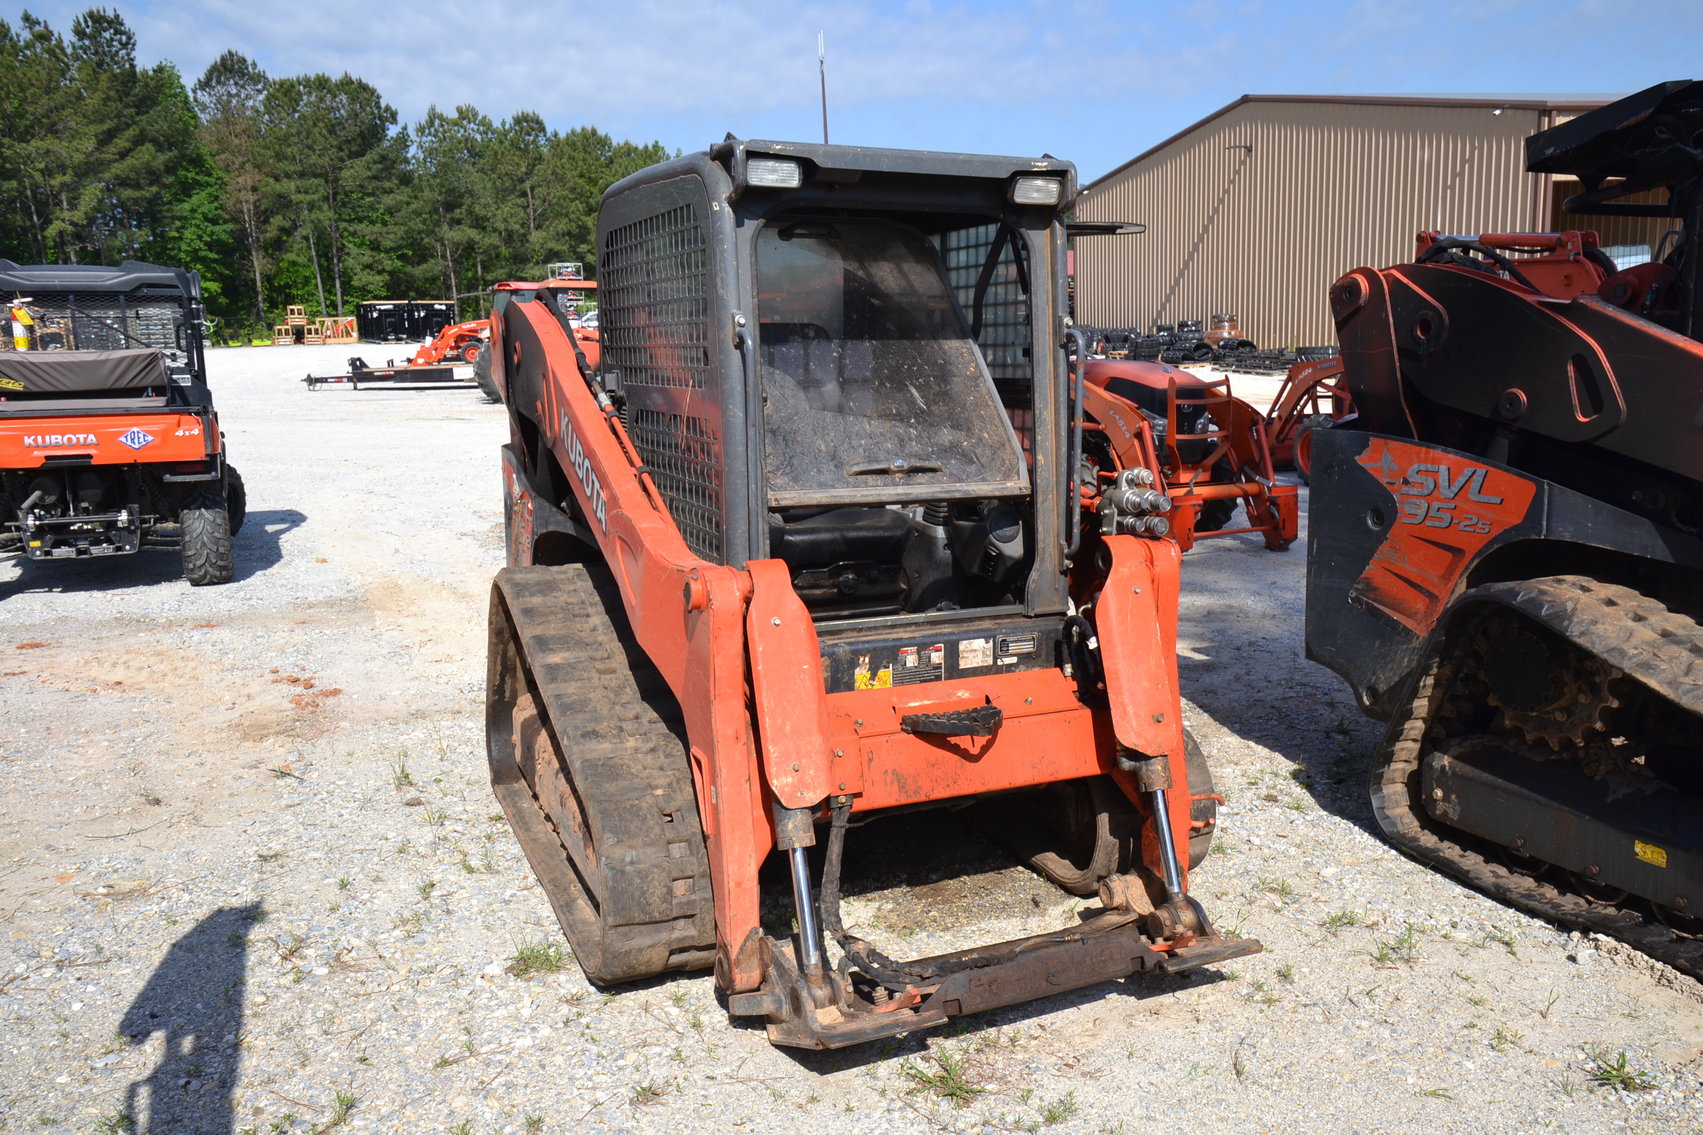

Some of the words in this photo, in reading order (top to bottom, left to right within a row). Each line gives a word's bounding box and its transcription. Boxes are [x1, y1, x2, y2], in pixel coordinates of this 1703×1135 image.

[23, 433, 99, 448] KUBOTA
[174, 427, 201, 437] 4x4
[560, 405, 607, 536] KUBOTA
[1400, 463, 1504, 504] SVL
